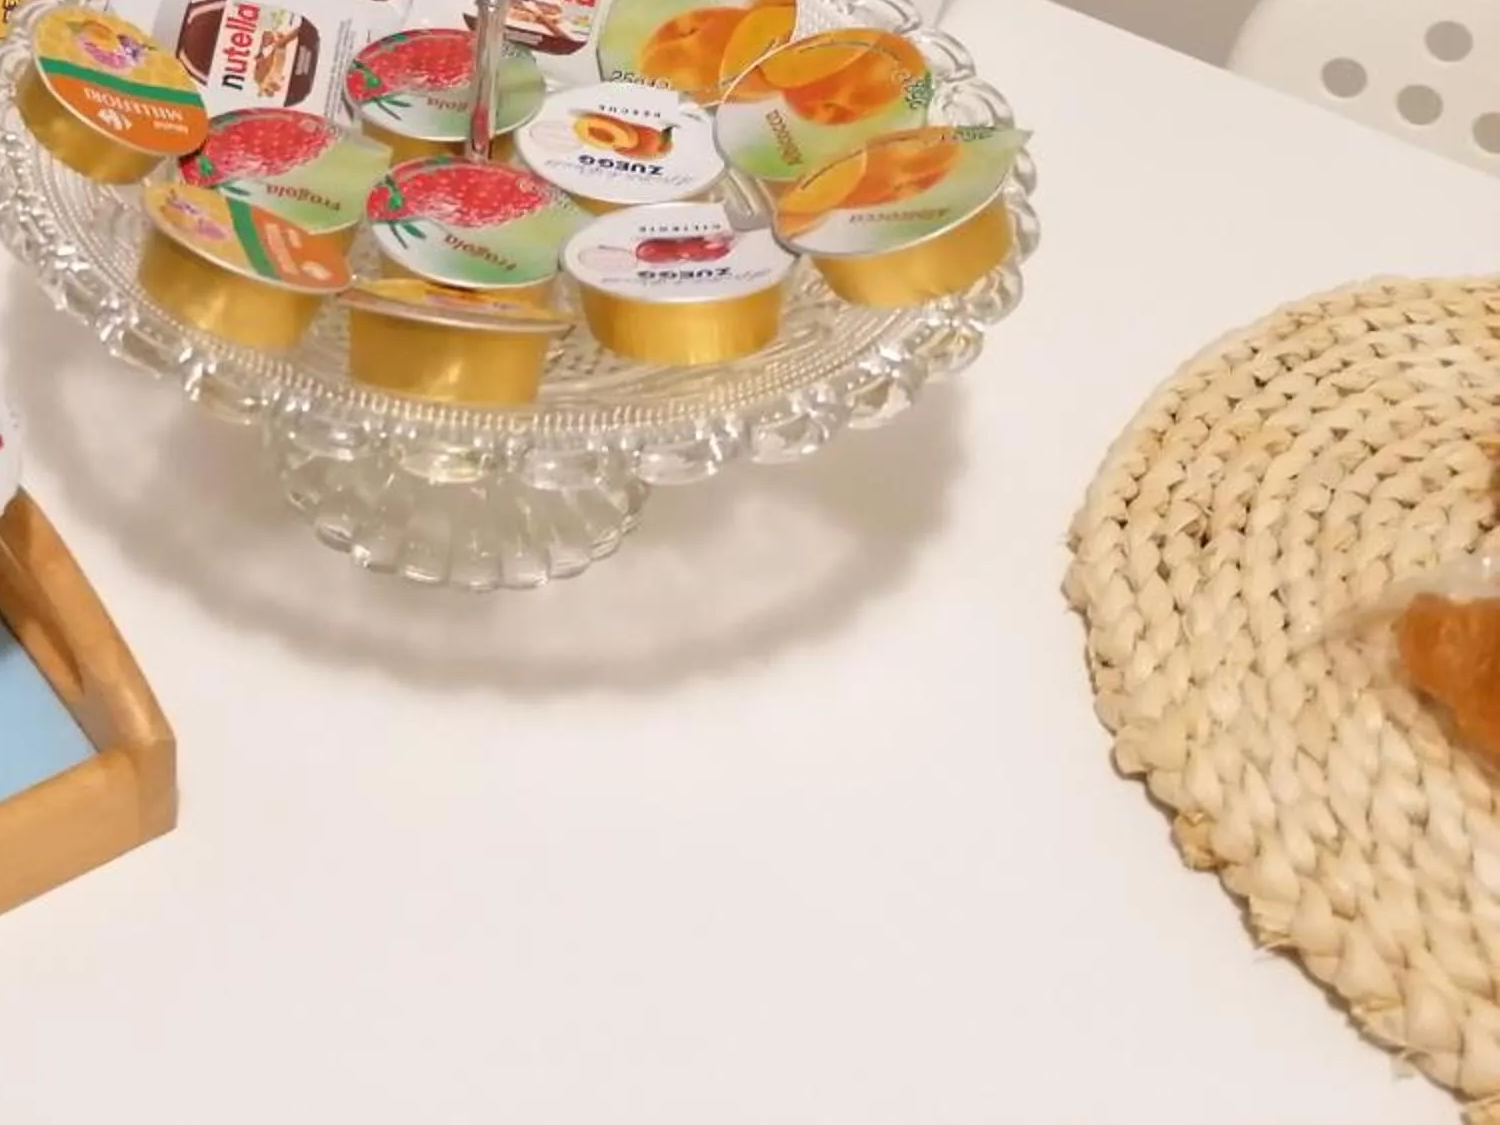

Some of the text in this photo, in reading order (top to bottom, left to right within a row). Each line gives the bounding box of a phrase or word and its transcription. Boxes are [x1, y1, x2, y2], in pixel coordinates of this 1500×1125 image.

[221, 3, 261, 92] nutella
[578, 153, 665, 177] ZUEGG
[265, 182, 342, 212] Fragola
[444, 232, 518, 272] Fragola
